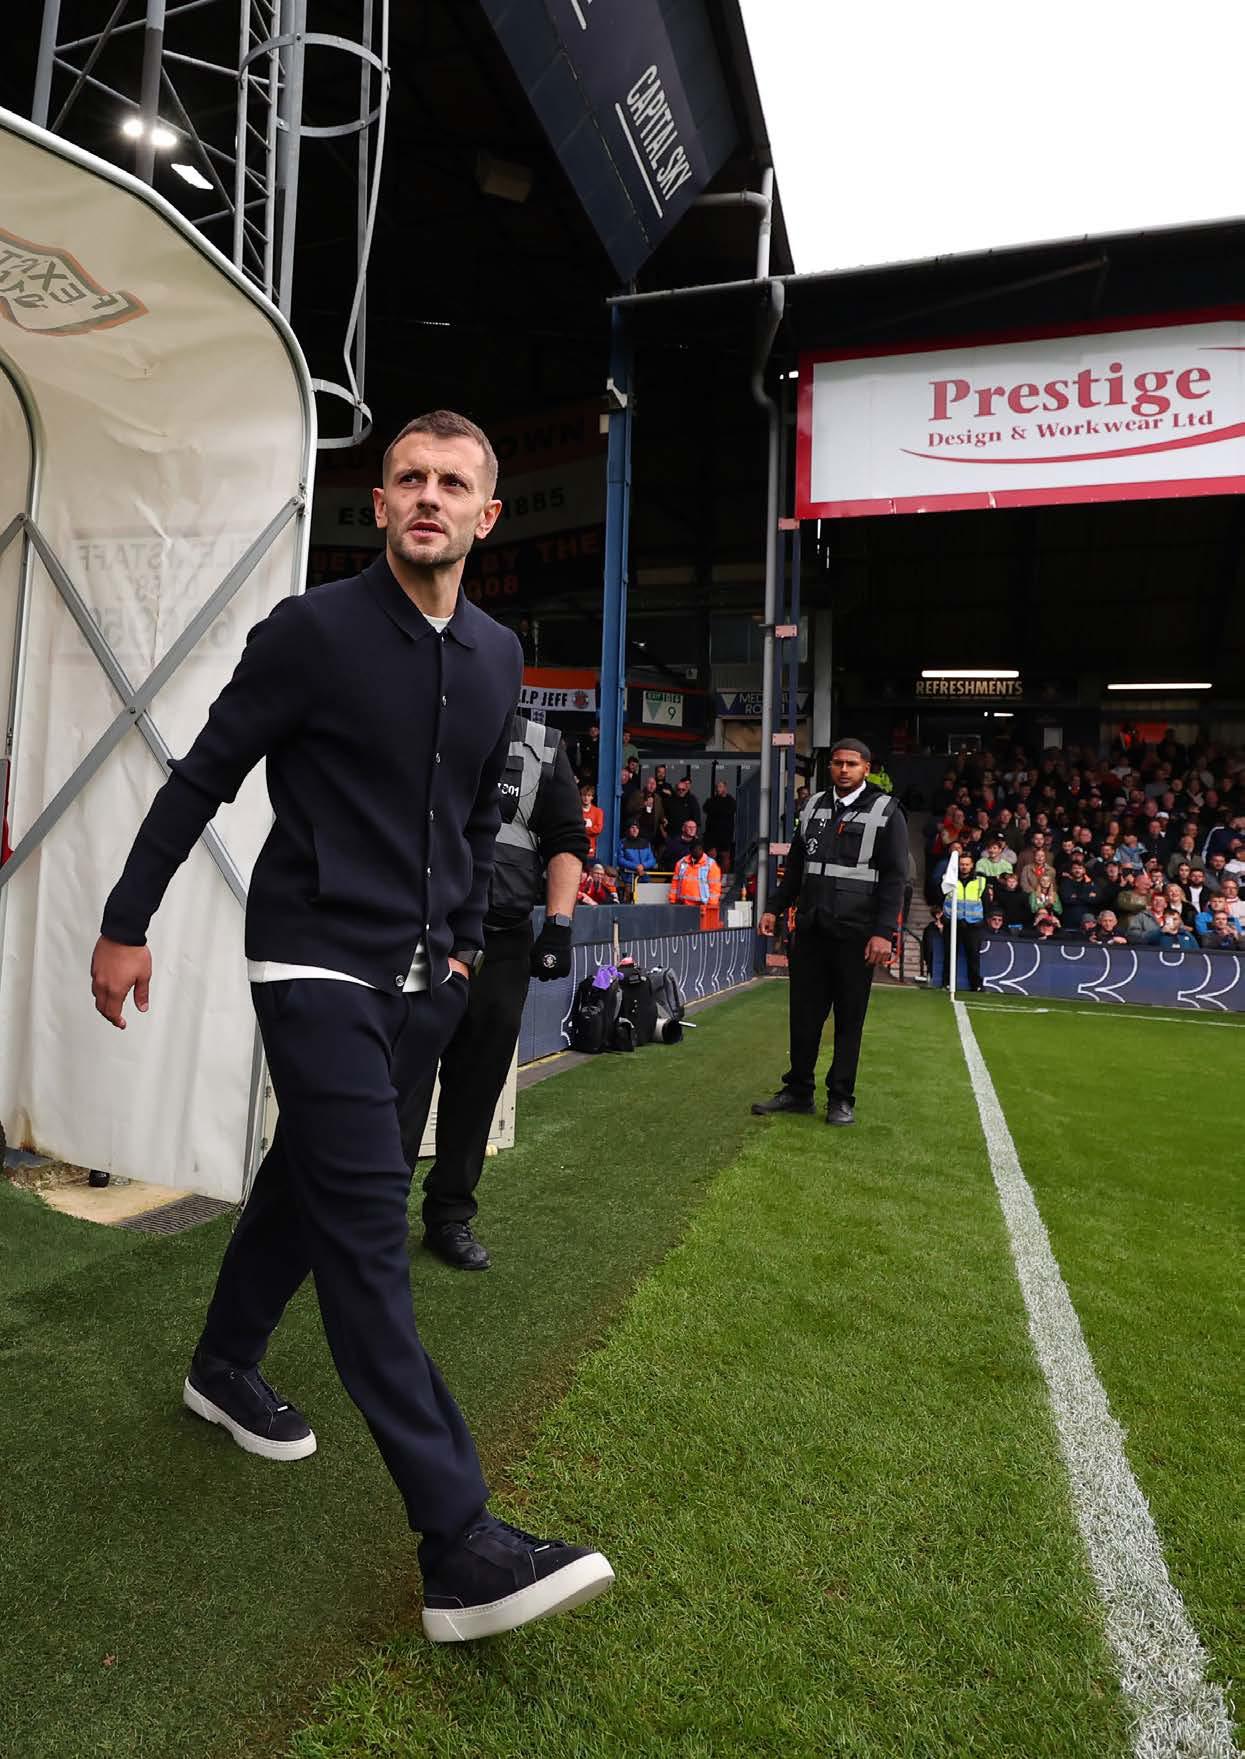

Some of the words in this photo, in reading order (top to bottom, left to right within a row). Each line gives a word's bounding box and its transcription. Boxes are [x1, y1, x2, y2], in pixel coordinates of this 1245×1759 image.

[627, 64, 677, 170] CAPITAL
[656, 145, 692, 200] SKY
[928, 362, 1212, 421] Prestige
[496, 419, 585, 457] OWN
[928, 430, 1002, 447] Design
[1010, 425, 1027, 440] &
[1036, 415, 1164, 438] Workwear
[1172, 410, 1213, 428] Ltd
[339, 506, 374, 527] ES
[464, 574, 520, 603] 008
[541, 692, 568, 707] JEFF
[915, 680, 1024, 695] REFRESHMENTS
[667, 706, 677, 720] 9
